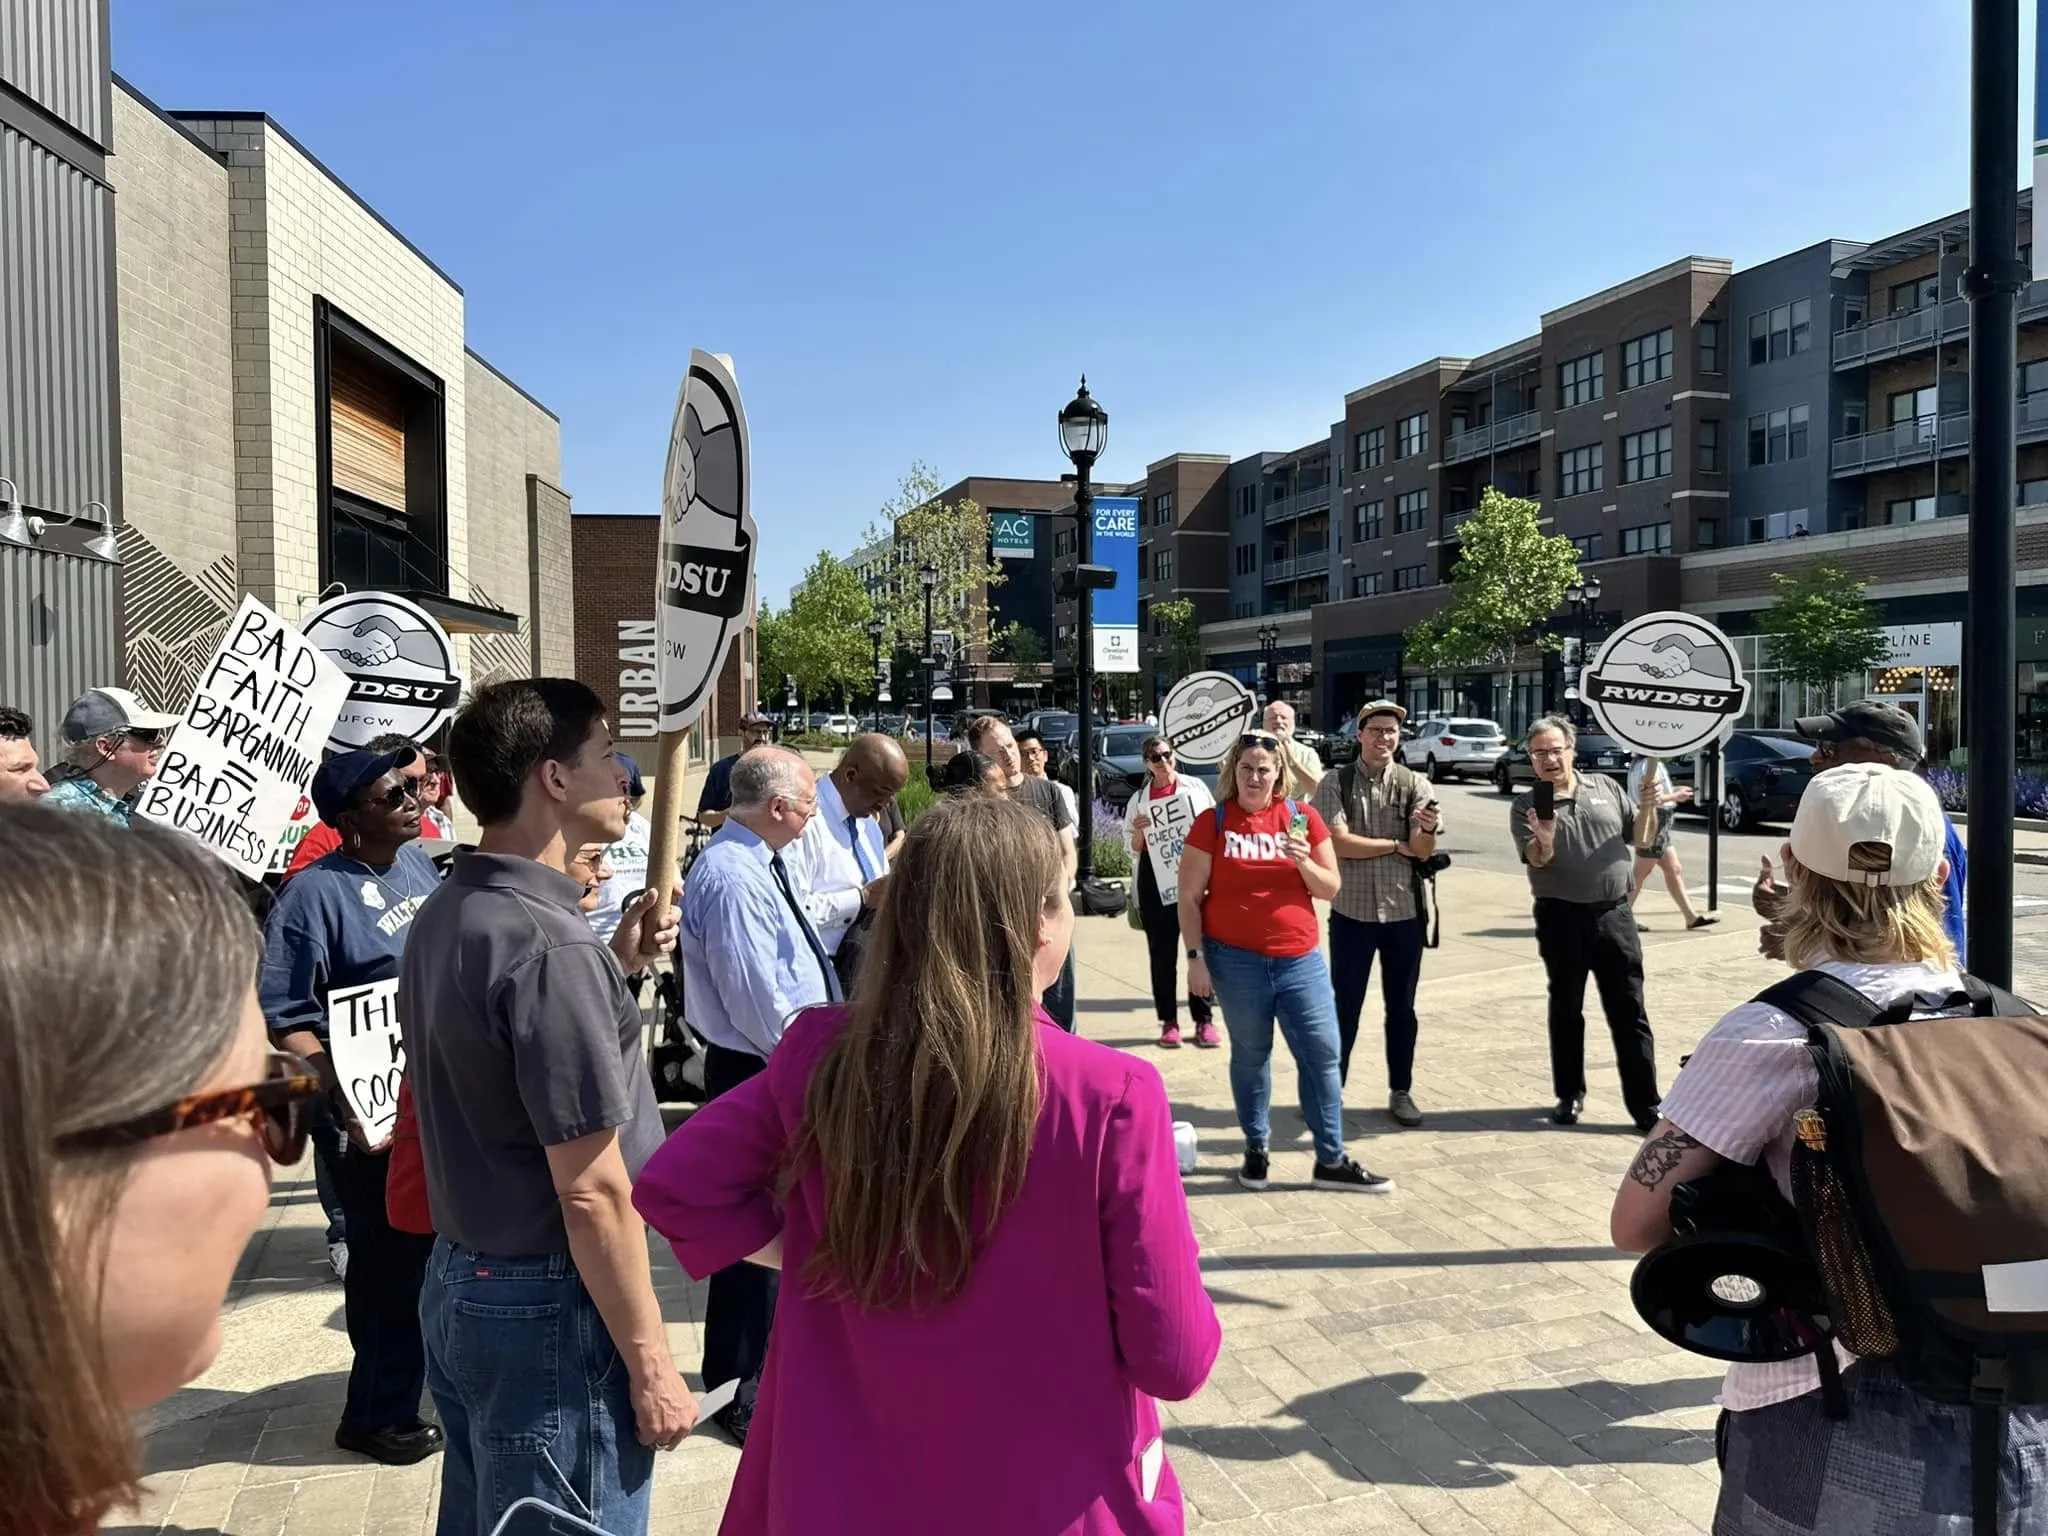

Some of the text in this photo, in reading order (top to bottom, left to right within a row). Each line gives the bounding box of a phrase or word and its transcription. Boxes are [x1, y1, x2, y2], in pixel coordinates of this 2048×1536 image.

[1095, 516, 1136, 531] CARE
[1096, 508, 1136, 517] FOR EVERY
[998, 519, 1029, 537] AC
[997, 537, 1030, 545] HOTELS
[664, 559, 731, 597] DSU
[230, 609, 316, 688] BAD
[618, 620, 660, 737] URBAN
[205, 652, 312, 743] FAITH
[353, 680, 443, 701] DSU
[1600, 685, 1729, 708] RWDSU
[338, 714, 393, 727] UFCW
[1173, 704, 1244, 747] RWDSU
[1635, 719, 1684, 730] UFCW
[157, 751, 256, 828] BAD 4
[146, 786, 266, 865] BUSINESS
[1147, 824, 1185, 847] CHECK
[1224, 830, 1288, 861] RWDS
